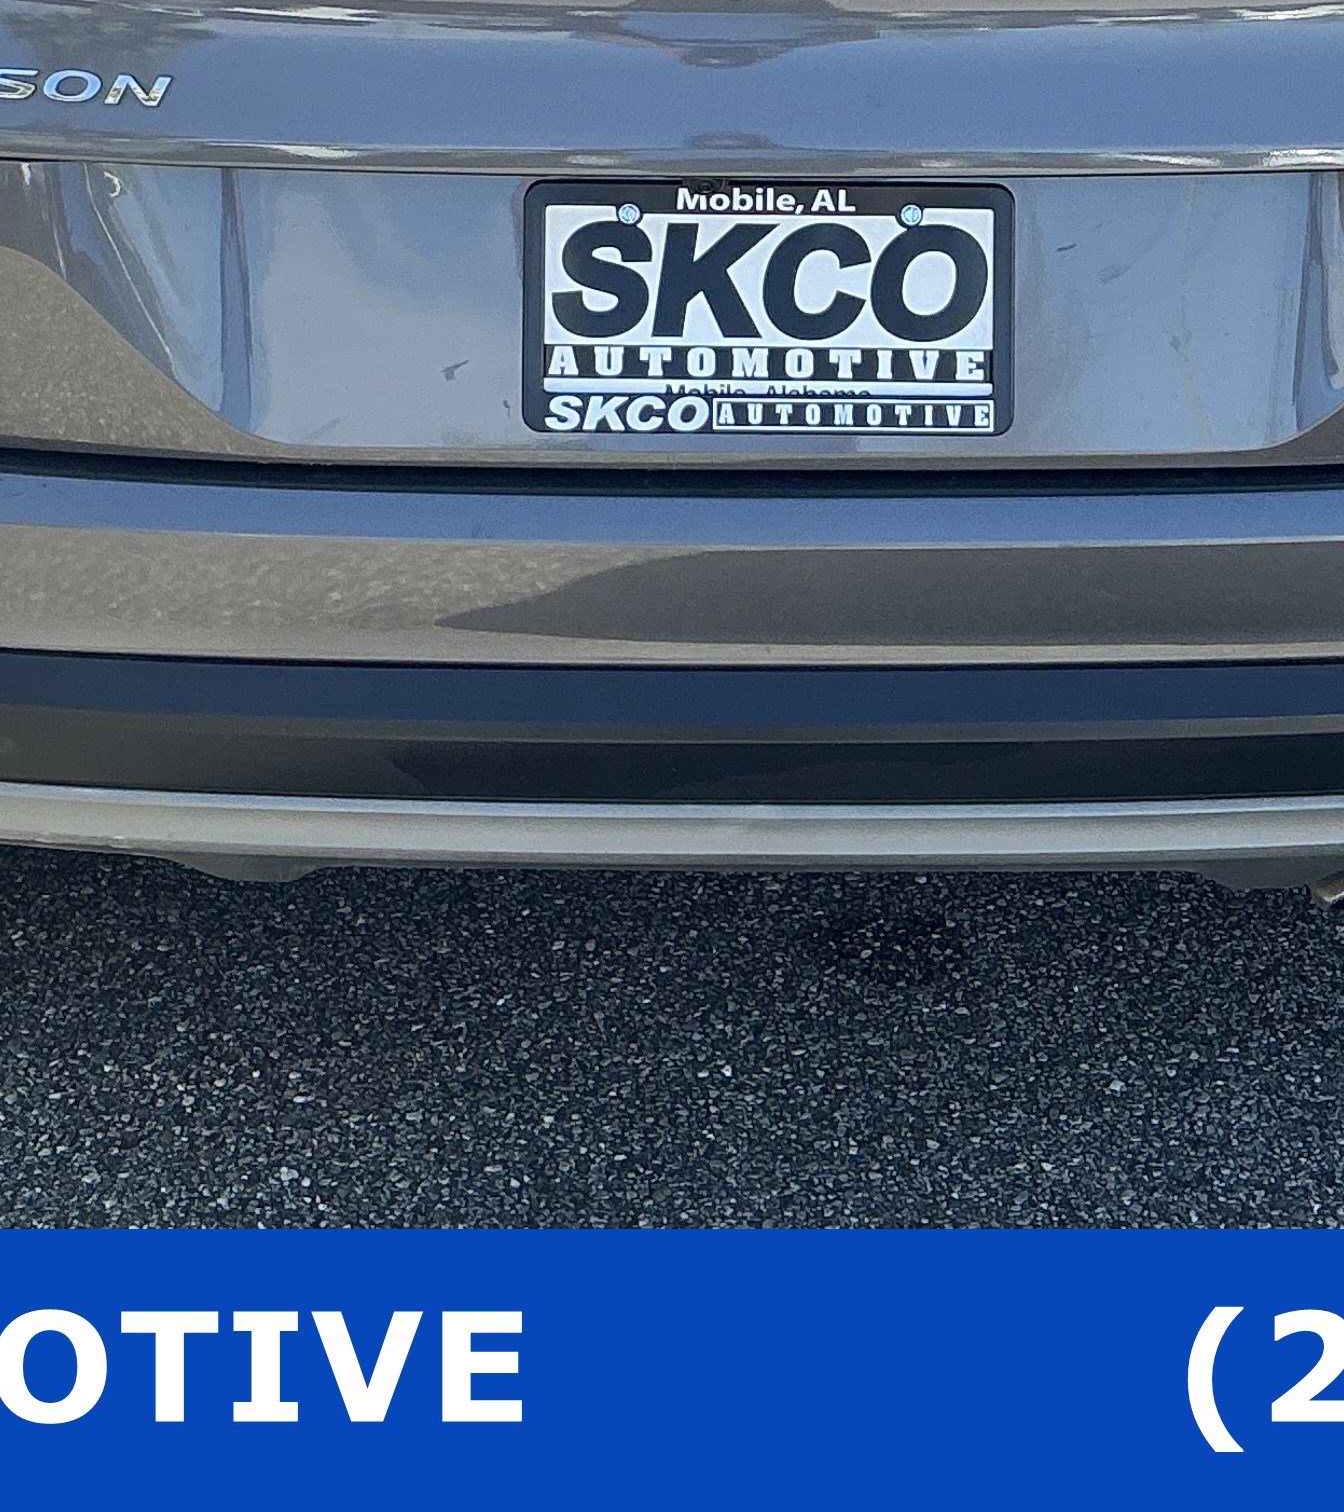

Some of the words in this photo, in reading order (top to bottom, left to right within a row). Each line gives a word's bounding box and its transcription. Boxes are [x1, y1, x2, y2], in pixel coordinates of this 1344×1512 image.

[676, 187, 804, 215] Mobile,
[810, 189, 856, 213] AL
[551, 219, 990, 343] SKCO
[548, 345, 985, 381] AUTOMOTIVE
[544, 395, 710, 431] SKCO
[719, 402, 990, 427] AUTOMOTIVE
